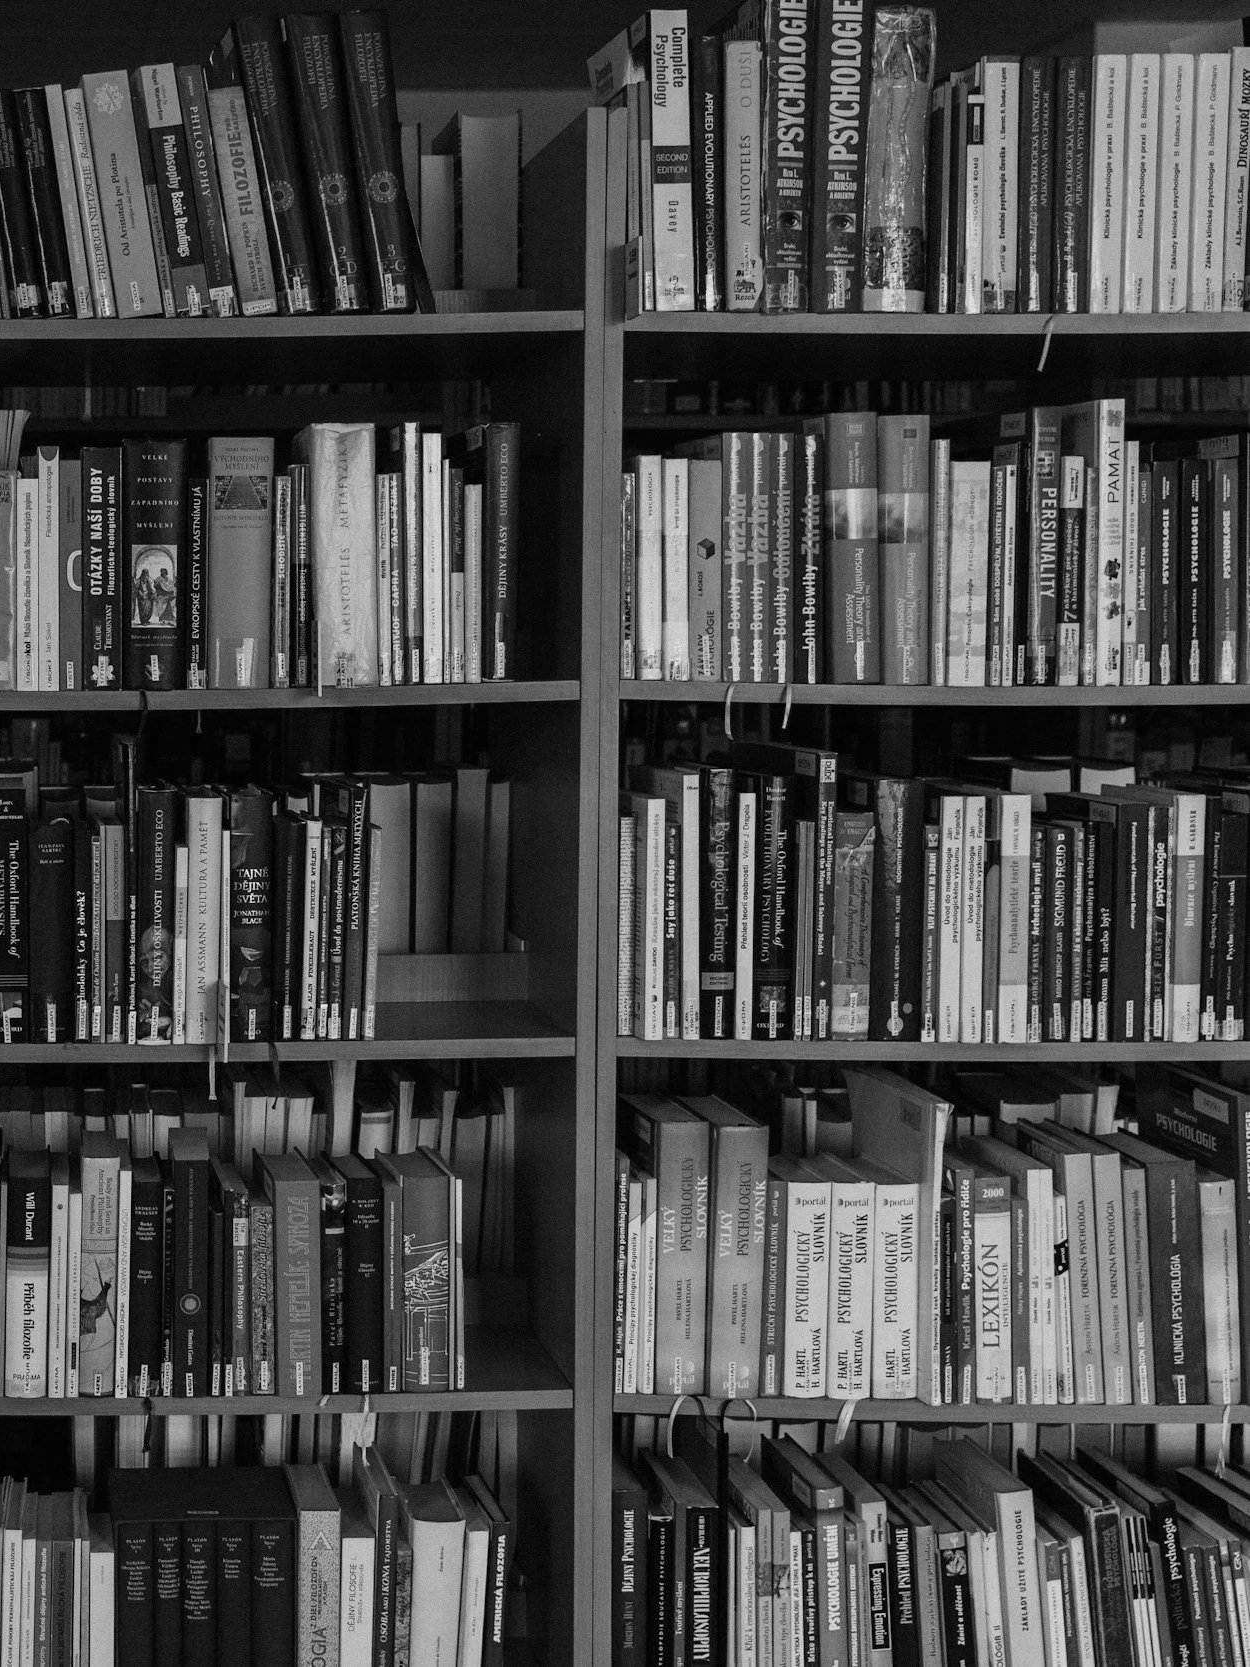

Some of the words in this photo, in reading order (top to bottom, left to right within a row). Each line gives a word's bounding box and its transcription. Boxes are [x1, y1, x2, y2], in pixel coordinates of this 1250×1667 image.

[654, 34, 669, 107] Psychology
[672, 27, 686, 88] Complete
[777, 0, 807, 158] PSYCHOLOGIE
[704, 93, 714, 131] APPLIED
[162, 135, 180, 188] Philosophy
[190, 106, 210, 197] PHILOSOPHY
[1105, 135, 1114, 153] praxi
[705, 133, 714, 205] EVOLUTIONARY
[1105, 162, 1114, 207] psychologie
[171, 192, 187, 216] Basic
[667, 201, 678, 233] Davey
[174, 218, 191, 257] Readings
[500, 444, 508, 463] ECO
[90, 468, 103, 502] DOBY
[192, 487, 203, 497] JÁ
[500, 466, 508, 516] UMBERTO
[88, 510, 103, 539] NAŠÍ
[192, 499, 201, 552] VLASTNÍMU
[498, 526, 508, 559] KRÁSY
[1039, 488, 1056, 598] PERSONALITY
[87, 546, 103, 595] OTÁZKY
[192, 562, 201, 590] CESTY
[498, 562, 507, 598] DĚJINY
[1138, 569, 1146, 596] zvládat
[191, 593, 201, 638] EVROPSKÉ
[1138, 598, 1146, 610] Jak
[154, 809, 164, 830] ECO
[196, 820, 210, 856] PAMĚŤ
[154, 833, 164, 881] UMBERTO
[666, 859, 676, 880] duše
[1055, 844, 1066, 878] FREUD
[1155, 842, 1166, 907] psychologie
[197, 869, 209, 915] KULTURA
[666, 882, 675, 897] řeč
[666, 901, 676, 920] jako
[1054, 880, 1065, 927] SIGMUND
[153, 890, 164, 949] OSKLIVOSTI
[666, 922, 676, 938] Sny
[151, 951, 164, 987] DĚJINY
[197, 922, 209, 973] ASSMANN
[197, 977, 208, 995] JAN
[24, 1191, 35, 1211] Will
[736, 1160, 752, 1257] PSYCHOLOGICKÝ
[752, 1180, 767, 1243] SLOVNÍK
[960, 1179, 970, 1207] řidiče
[24, 1212, 36, 1241] Durant
[717, 1209, 733, 1258] VELKÝ
[812, 1212, 826, 1262] SLOVNÍK
[962, 1209, 971, 1228] pro
[793, 1230, 810, 1323] PSYCHOLOGICKÝ
[960, 1230, 972, 1290] Psychologie
[979, 1243, 1001, 1349] LEXIKÓN
[1169, 1254, 1183, 1319] PSYCHOLÓGIA
[796, 1348, 806, 1378] HARTL
[810, 1328, 821, 1375] HARTLOVÁ
[1171, 1322, 1185, 1364] KLINICKÁ
[823, 1525, 839, 1559] UMĚNÍ
[895, 1528, 912, 1588] PSYCHOLOGIE
[1013, 1510, 1025, 1565] PSYCHOLOGIE
[495, 1536, 506, 1588] FILOZOFIA
[1016, 1568, 1027, 1592] UŽITÉ
[492, 1590, 505, 1645] AMERICKÁ
[693, 1547, 710, 1661] NEUROPHILOSOPHY
[826, 1561, 840, 1631] PSYCHOLOGIE
[898, 1591, 913, 1624] Přehled
[1019, 1596, 1029, 1631] ZÁKLADY
